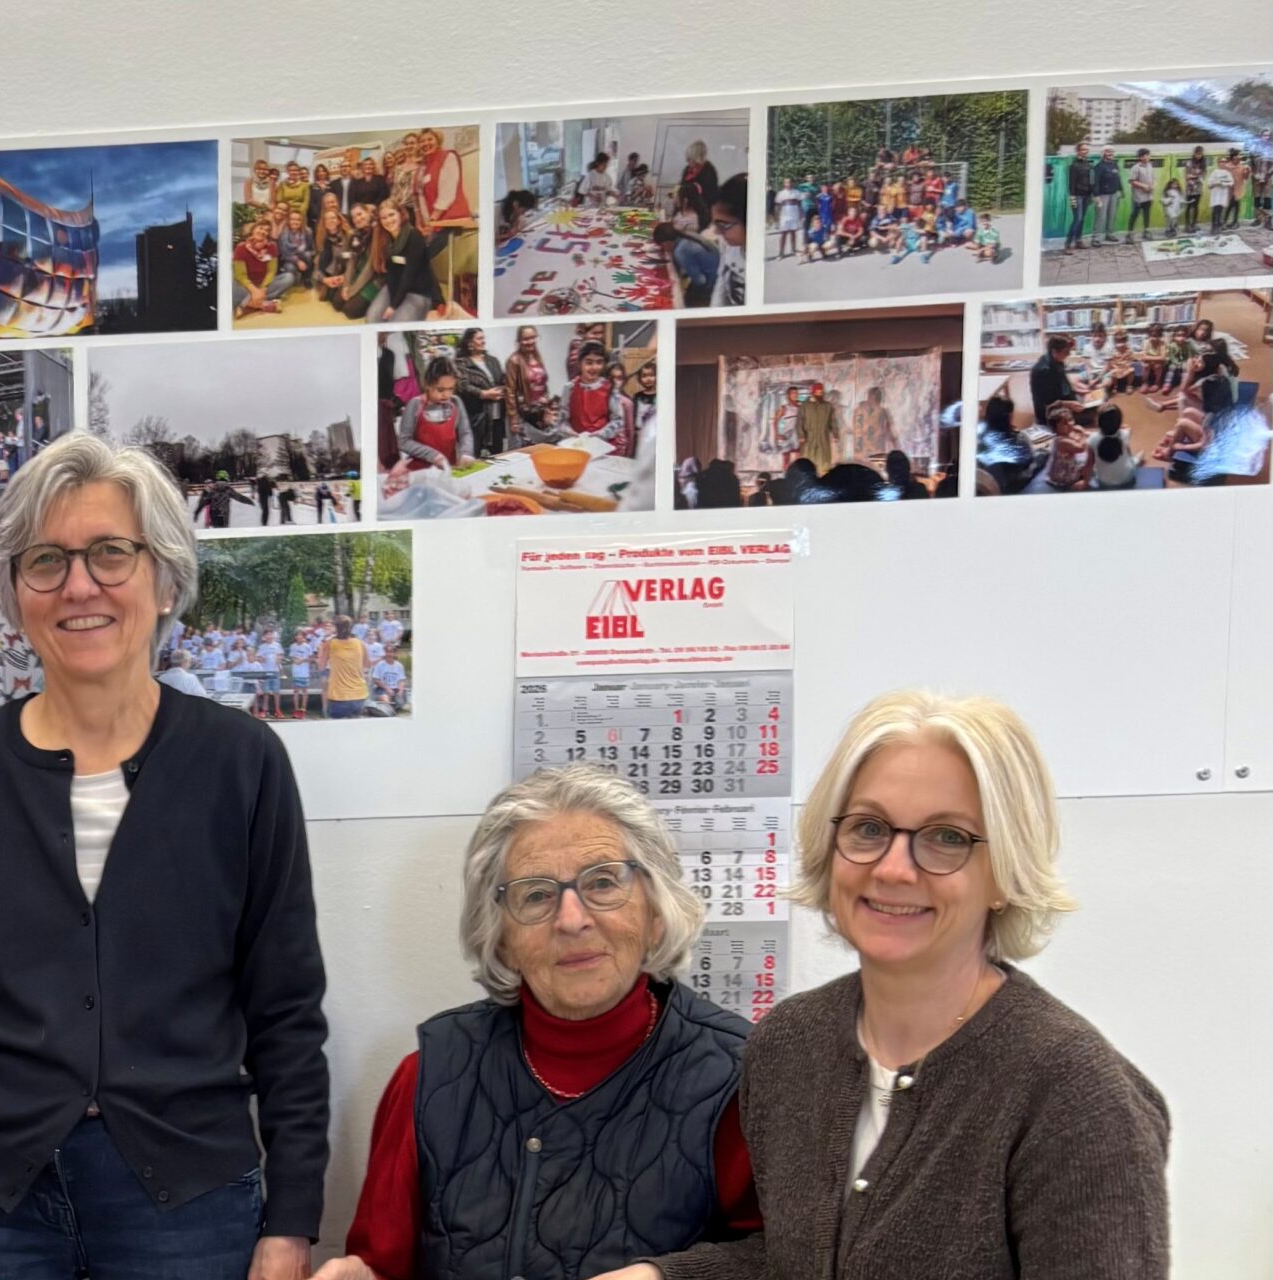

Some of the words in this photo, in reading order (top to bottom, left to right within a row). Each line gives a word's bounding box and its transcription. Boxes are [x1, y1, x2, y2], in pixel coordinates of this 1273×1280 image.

[618, 548, 675, 558] Produkte
[708, 545, 737, 555] EIBL
[739, 543, 791, 554] VERLAG
[621, 576, 725, 602] VERLAG
[585, 614, 645, 640] EIBL
[673, 708, 683, 724] 1
[704, 707, 717, 723] 2
[736, 707, 748, 722] 3
[767, 706, 781, 722] 4
[575, 729, 587, 744] 5
[607, 727, 618, 743] 6
[639, 727, 651, 742] 7
[671, 726, 684, 741] 8
[703, 725, 716, 741] 9
[728, 725, 747, 740] 10
[758, 724, 778, 739] 11
[566, 746, 587, 760] 12
[597, 746, 619, 761] 13
[629, 745, 651, 760] 14
[662, 744, 683, 759] 15
[694, 743, 716, 758] 16
[728, 742, 747, 757] 17
[758, 741, 779, 757] 18
[627, 762, 649, 777] 21
[660, 761, 682, 776] 22
[692, 760, 715, 776] 23
[724, 760, 747, 775] 24
[755, 759, 779, 774] 25
[659, 779, 682, 794] 29
[691, 778, 714, 793] 30
[724, 778, 746, 793] 31
[766, 831, 776, 847] 1
[701, 850, 712, 865] 6
[732, 850, 744, 865] 7
[764, 849, 776, 864] 8
[692, 867, 713, 882] 13
[723, 867, 744, 882] 14
[755, 866, 776, 881] 15
[721, 884, 743, 899] 21
[753, 883, 776, 898] 22
[721, 902, 744, 916] 28
[766, 901, 775, 915] 1
[700, 956, 712, 971] 6
[732, 956, 743, 970] 7
[764, 955, 775, 970] 8
[691, 973, 711, 988] 13
[723, 973, 743, 988] 14
[754, 972, 775, 987] 15
[721, 990, 741, 1005] 21
[751, 990, 774, 1004] 22
